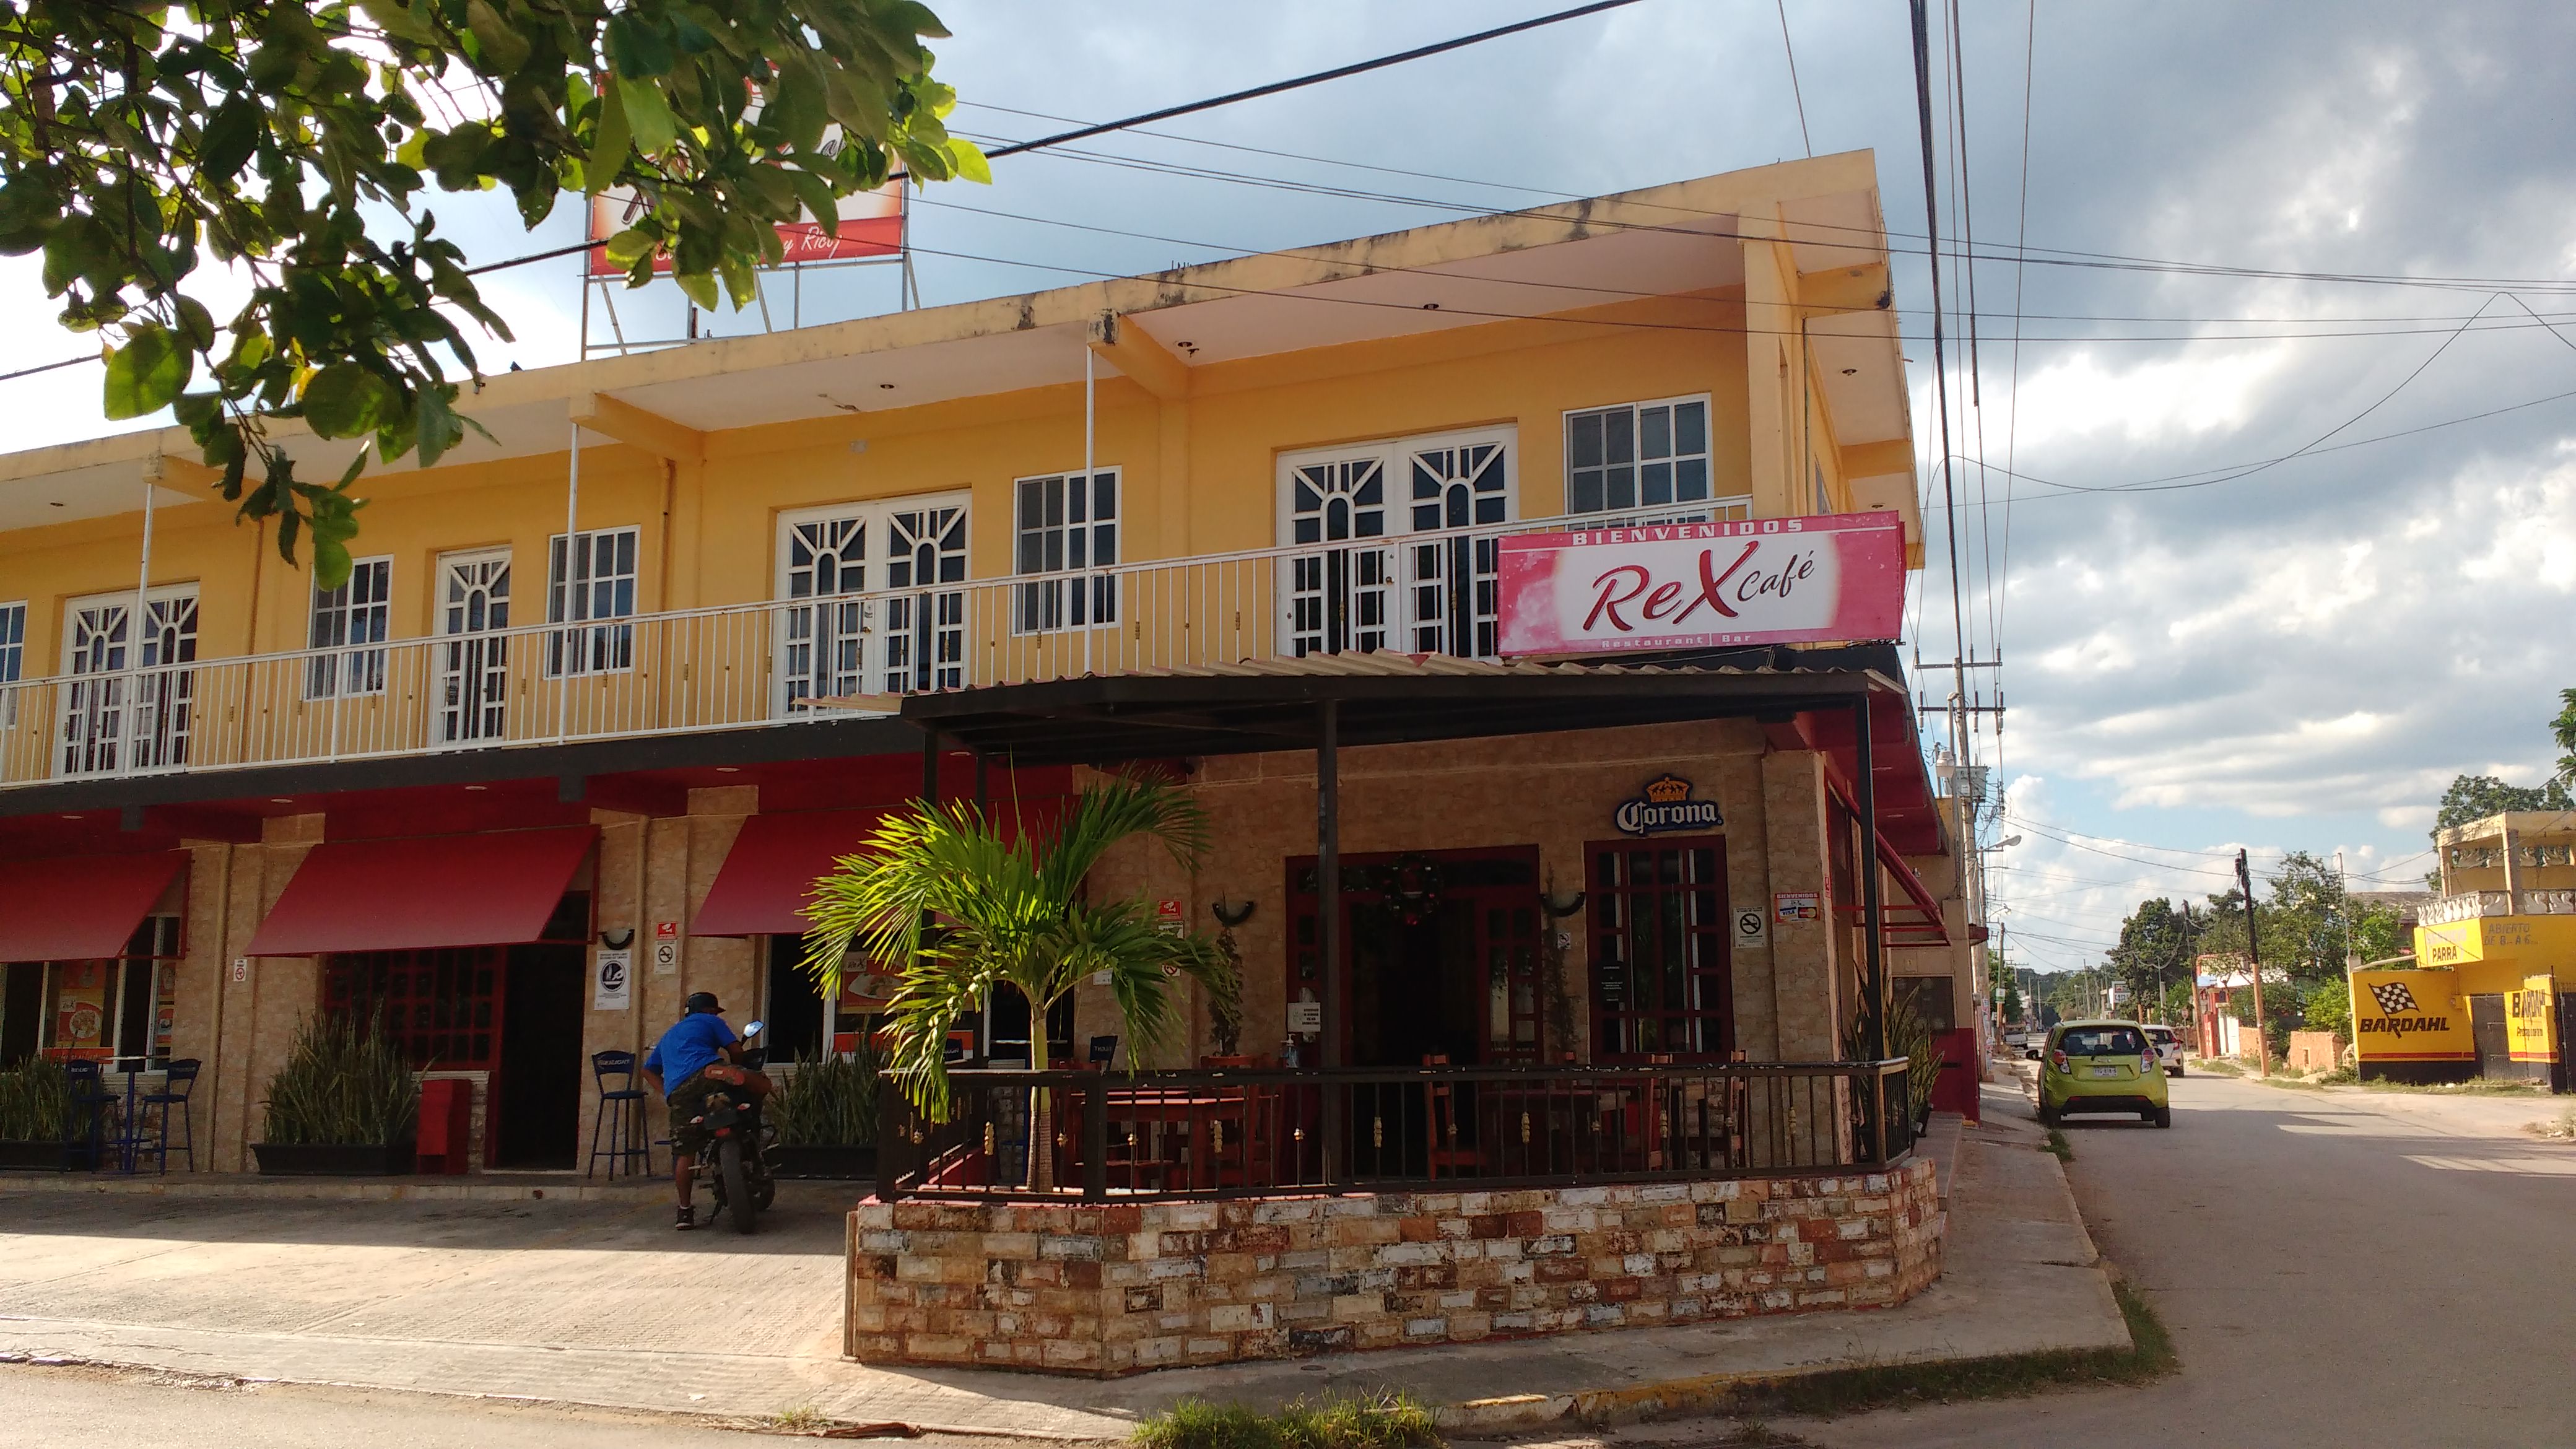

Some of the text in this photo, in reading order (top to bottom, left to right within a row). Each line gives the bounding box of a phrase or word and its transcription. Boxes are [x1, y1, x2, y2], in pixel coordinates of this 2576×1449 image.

[1572, 518, 1804, 546] BIENVENIDOS
[1601, 634, 1751, 648] Restaurant Bar
[1617, 801, 1718, 834] Corona
[2487, 923, 2530, 934] ABIERTO
[2432, 946, 2458, 962] PARRA
[2359, 1017, 2452, 1038] BARDAHL
